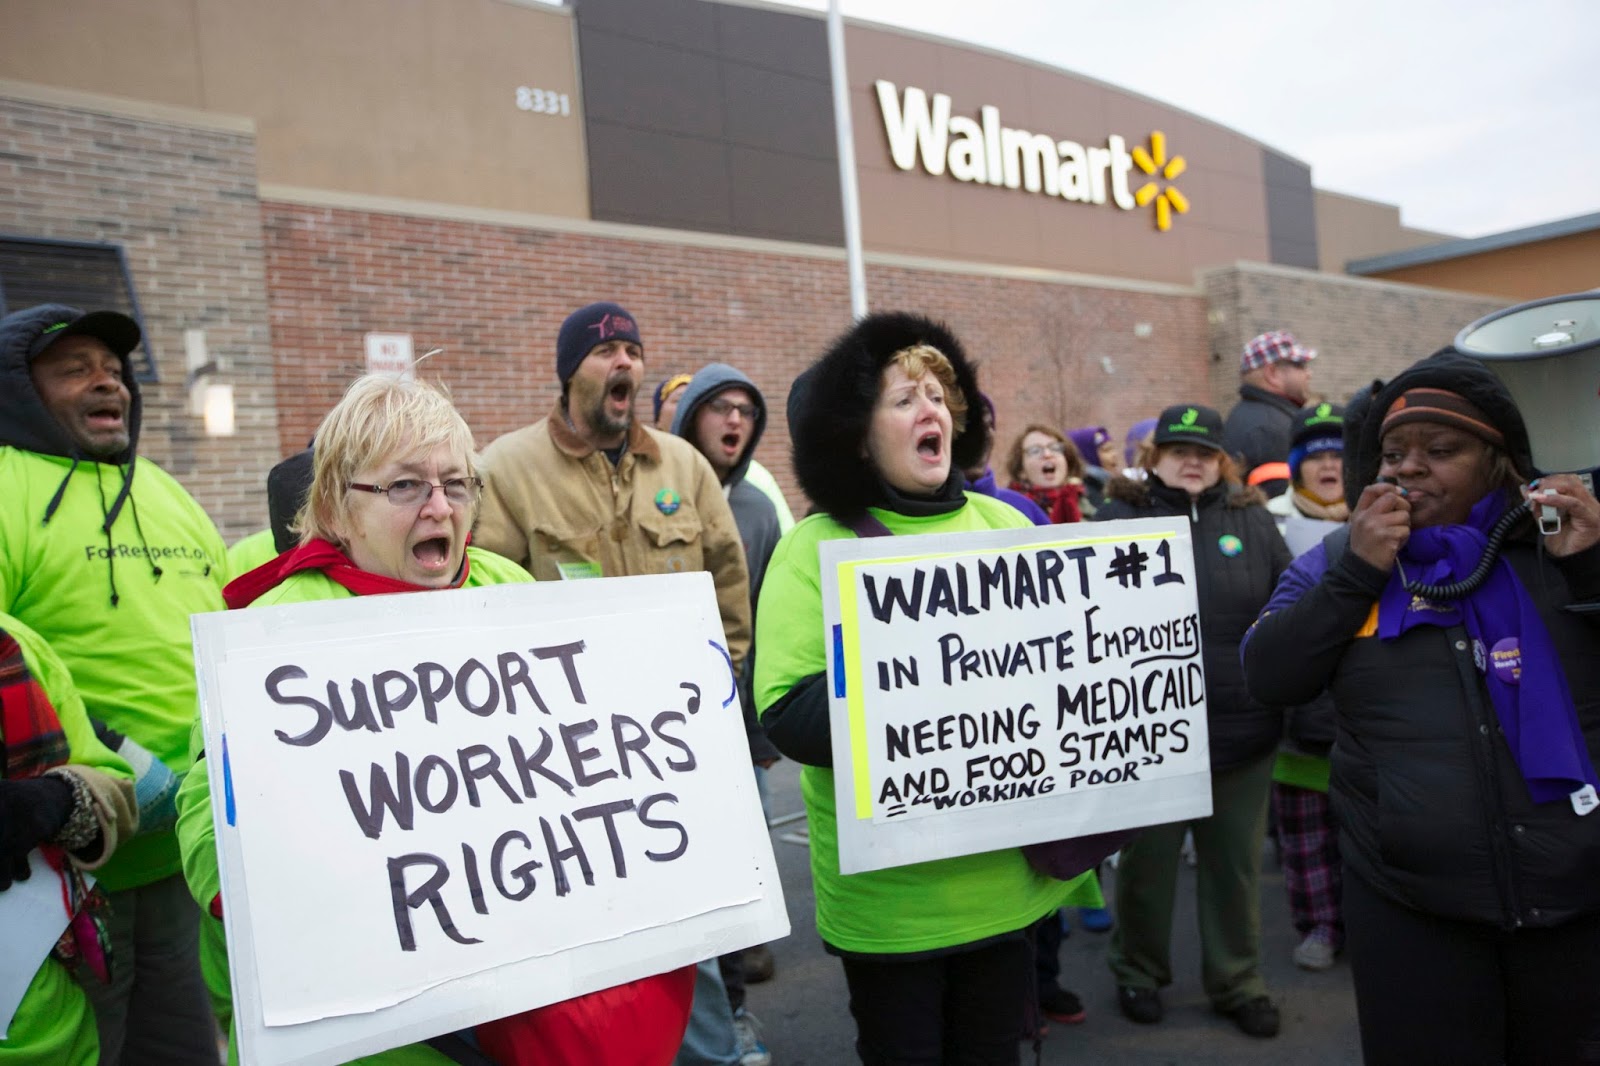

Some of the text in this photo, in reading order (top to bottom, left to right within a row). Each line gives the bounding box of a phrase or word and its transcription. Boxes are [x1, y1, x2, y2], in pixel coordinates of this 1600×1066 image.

[515, 85, 570, 117] 8331
[875, 78, 1135, 210] Walmart
[862, 538, 1186, 624] WALMART #1
[264, 640, 588, 747] SUPPORT
[876, 655, 920, 692] IN
[938, 629, 1075, 686] PRIVATE
[885, 662, 1204, 762] NEEDING MEDICAID
[878, 719, 1190, 805] AND FOOD STAMPS
[386, 792, 689, 952] RIGHTS
